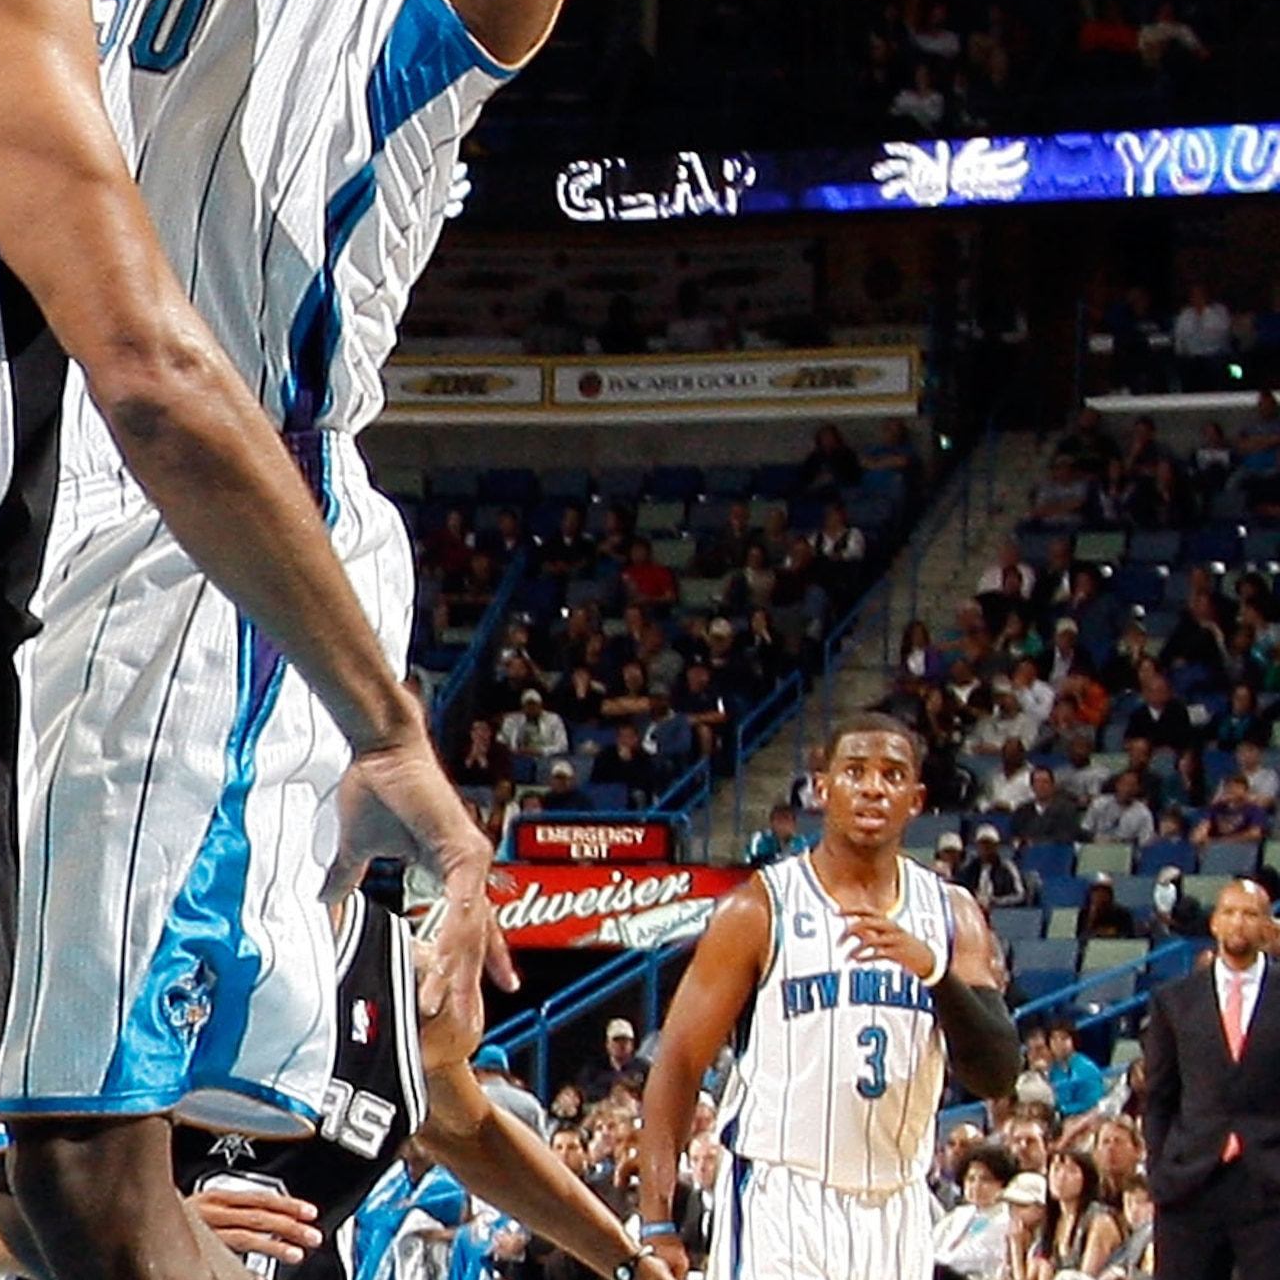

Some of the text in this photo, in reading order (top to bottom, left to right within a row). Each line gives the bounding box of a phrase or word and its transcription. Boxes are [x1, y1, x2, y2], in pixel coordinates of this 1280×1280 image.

[535, 825, 646, 845] EMERGENCY
[570, 843, 610, 859] EXIT
[793, 911, 817, 939] C
[781, 969, 842, 1021] NEW
[856, 1024, 889, 1099] 3
